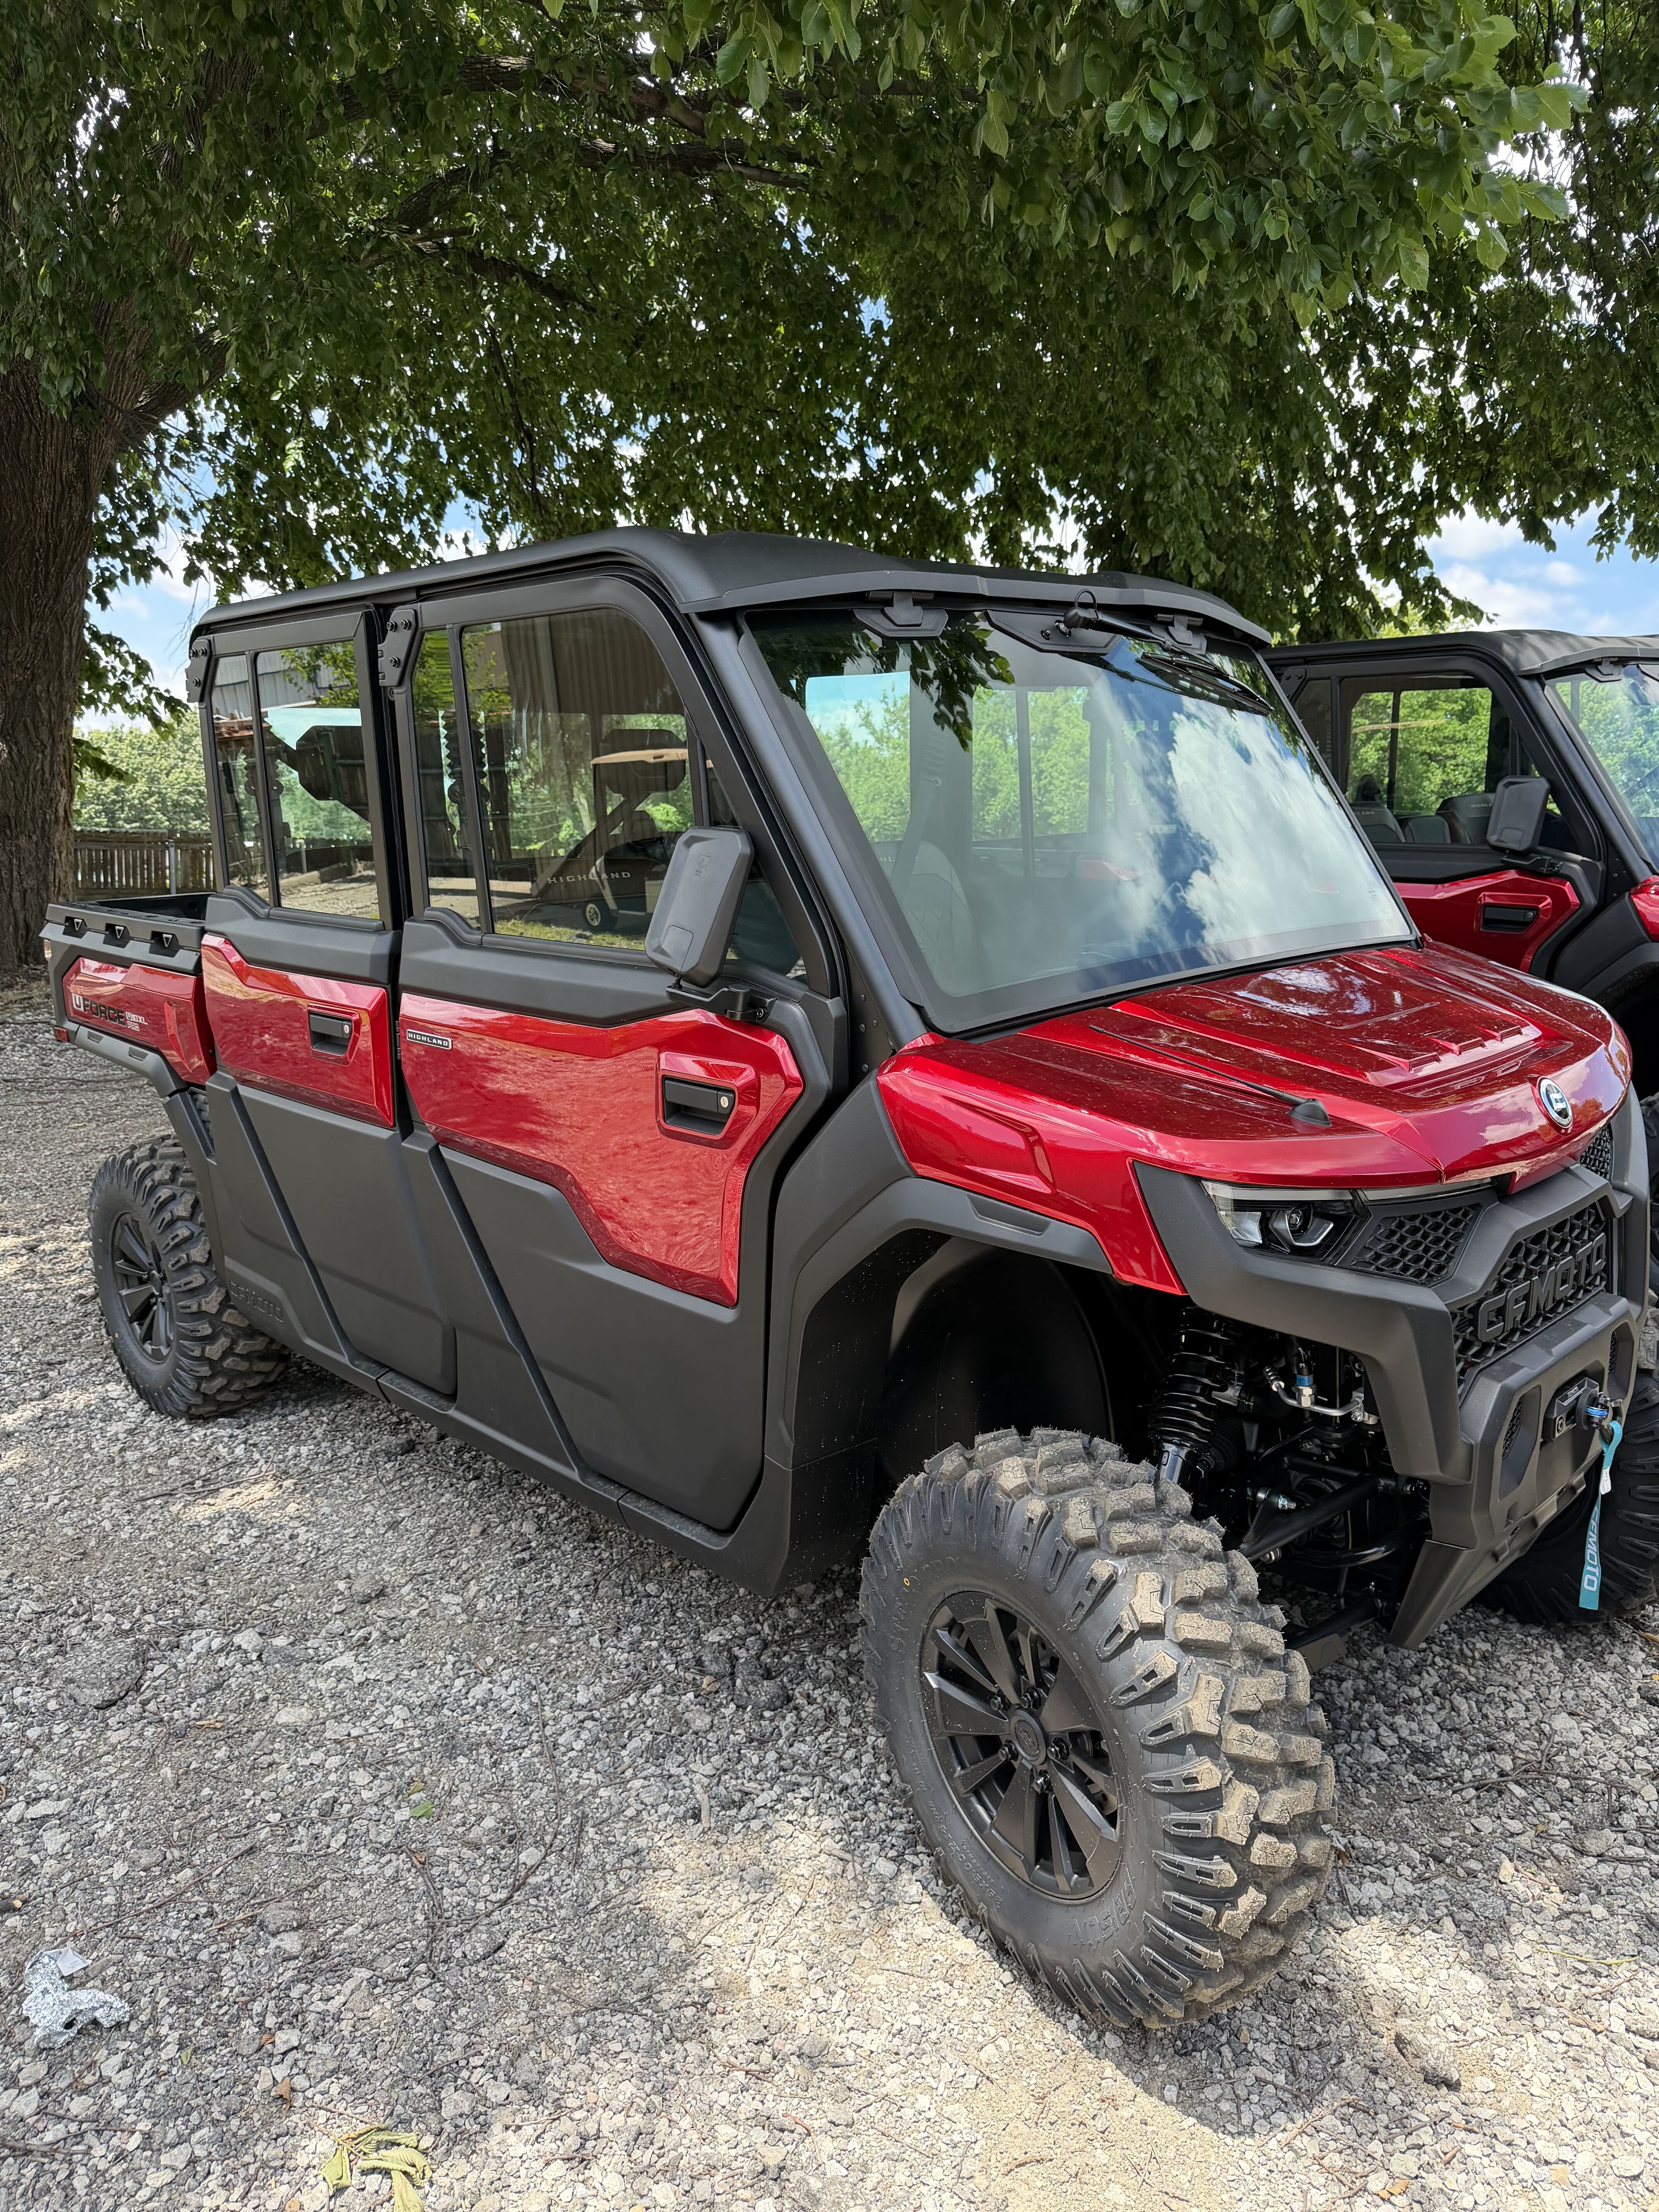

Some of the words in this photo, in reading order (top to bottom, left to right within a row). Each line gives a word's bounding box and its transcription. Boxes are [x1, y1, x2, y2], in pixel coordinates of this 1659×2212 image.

[547, 872, 631, 884] HIGHLAND
[408, 1032, 448, 1046] HIGHLAND
[229, 1281, 284, 1323] CFMOTO
[1478, 1231, 1606, 1343] CFMOTO
[1583, 1506, 1599, 1592] CFMOTO
